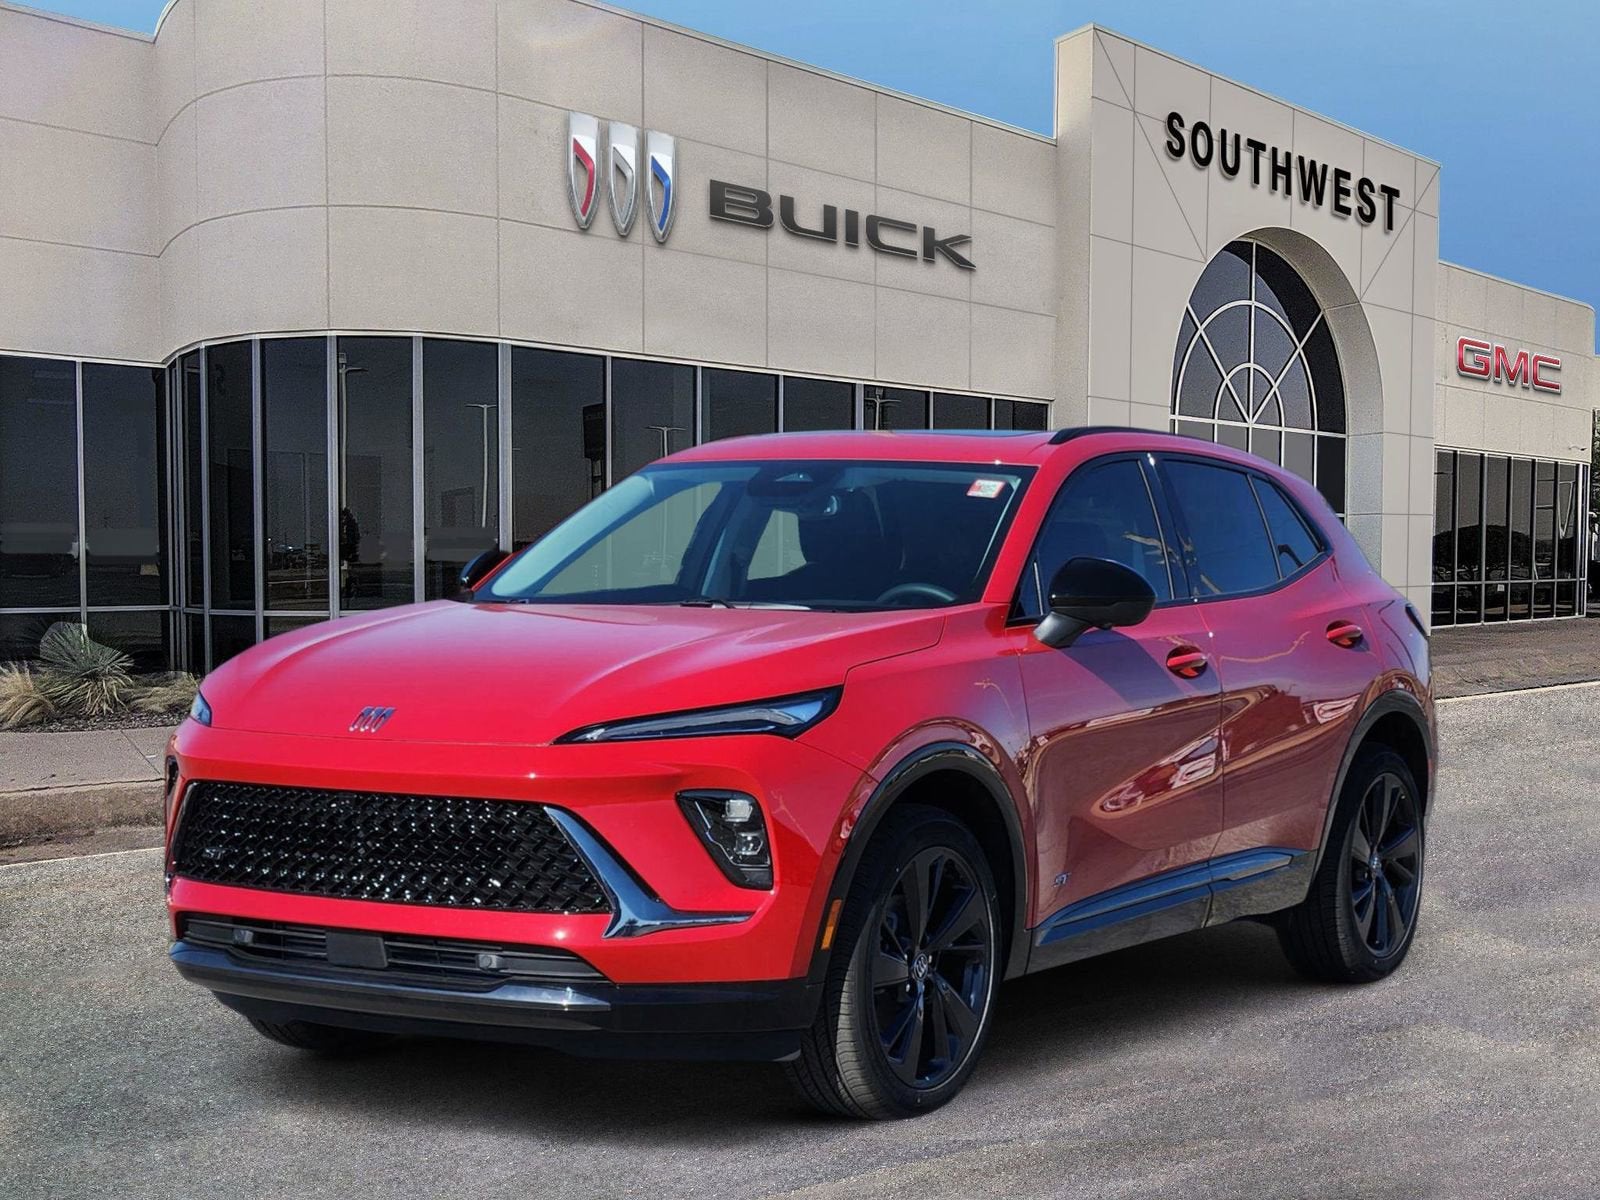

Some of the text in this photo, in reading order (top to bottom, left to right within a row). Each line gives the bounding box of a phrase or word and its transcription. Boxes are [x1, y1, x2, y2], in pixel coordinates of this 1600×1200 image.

[1165, 111, 1400, 232] SOUTHWEST
[709, 179, 977, 271] BUICK
[1457, 336, 1562, 393] GMC
